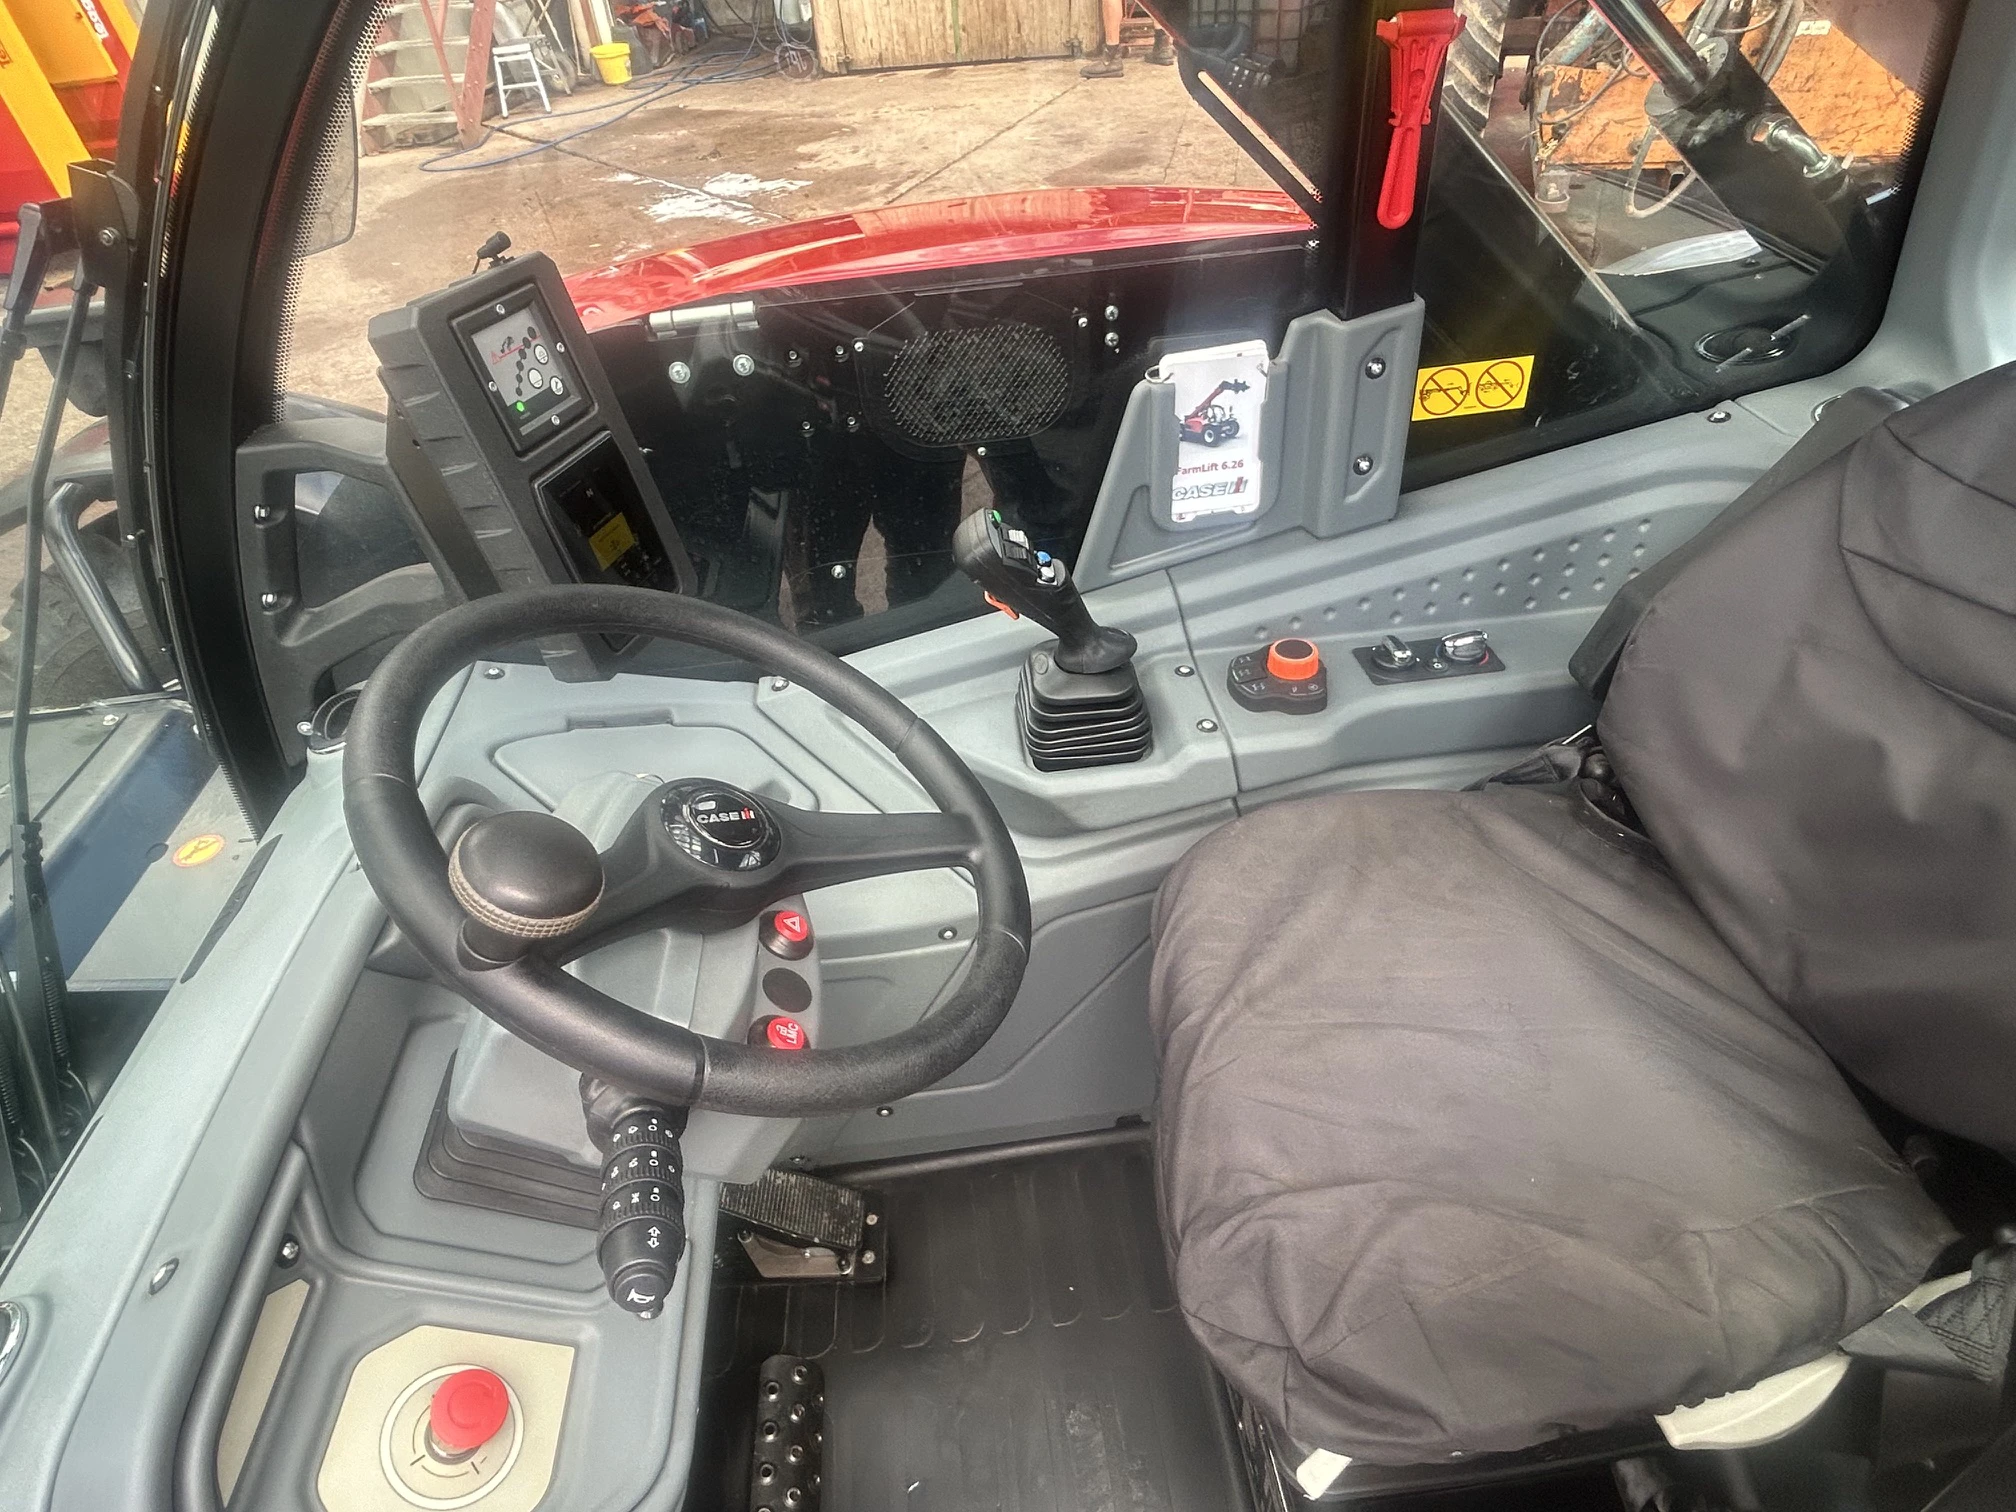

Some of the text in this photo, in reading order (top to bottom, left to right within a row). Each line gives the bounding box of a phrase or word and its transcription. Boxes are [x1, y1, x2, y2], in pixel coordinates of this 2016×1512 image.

[1221, 459, 1244, 470] 6.26
[1172, 481, 1228, 501] CASE
[697, 811, 740, 824] CASE
